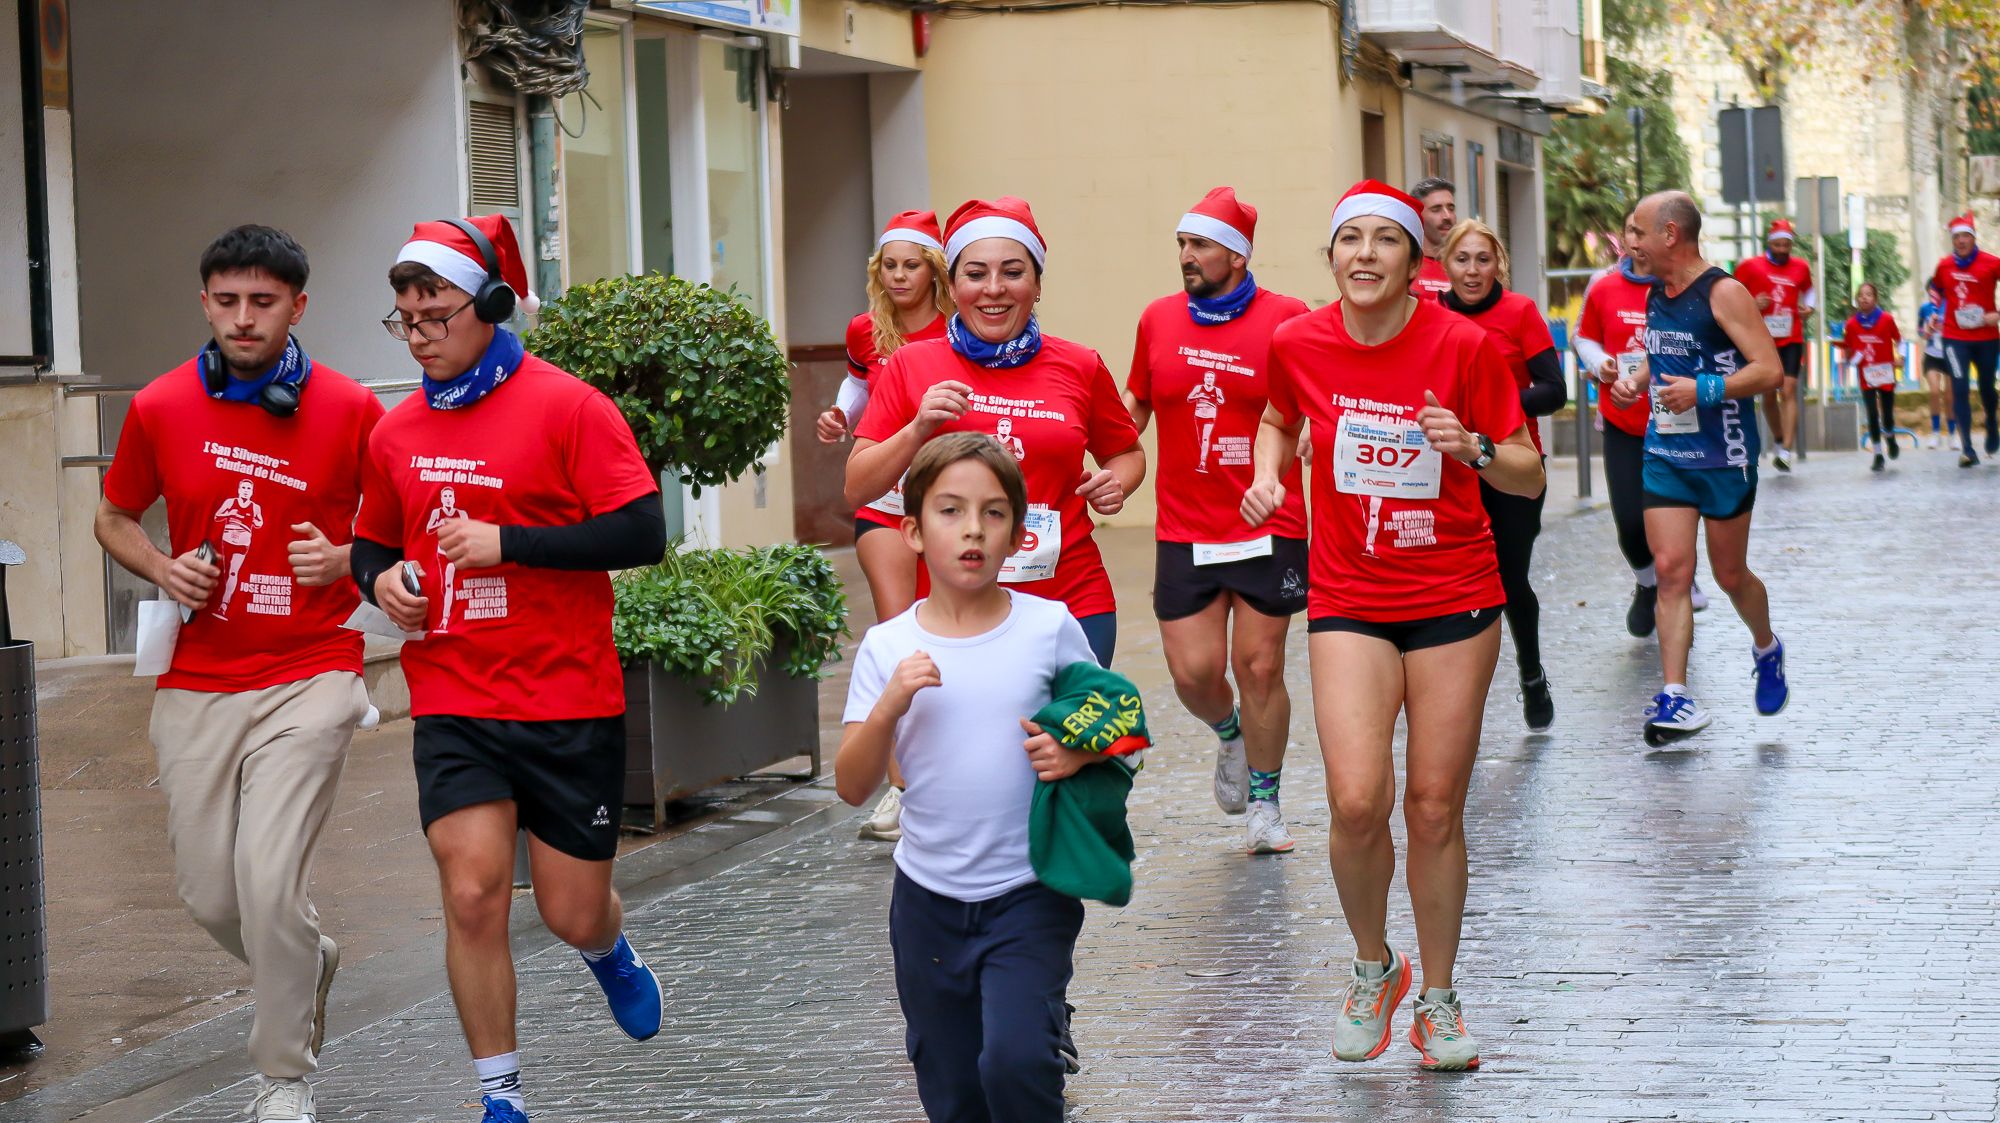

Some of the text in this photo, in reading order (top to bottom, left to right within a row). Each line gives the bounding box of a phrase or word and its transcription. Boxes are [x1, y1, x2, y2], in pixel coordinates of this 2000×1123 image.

[1660, 331, 1693, 341] NOCTURNA
[1183, 347, 1198, 357] San
[1199, 349, 1233, 362] Silvestre
[1187, 356, 1254, 377] Ciudad de Lucena
[967, 392, 1035, 408] San Silvestre
[1332, 393, 1405, 415] I San Silvestre
[973, 403, 1065, 422] Ciudad de Lucena
[1347, 431, 1368, 439] Ciudad
[1378, 436, 1400, 444] Lucena
[1361, 426, 1387, 436] Silvestre
[203, 441, 280, 468] I San Silvestre
[1356, 444, 1421, 468] 307
[410, 456, 417, 468] I
[416, 456, 434, 468] San
[434, 456, 476, 471] Silvestre
[216, 456, 307, 491] Ciudad de Lucena
[420, 469, 503, 489] Ciudad de Lucena
[1392, 510, 1434, 521] MEMORIAL
[1384, 519, 1434, 531] JOSE CARLOS
[1398, 527, 1433, 538] HURTADO
[250, 574, 292, 585] MEMORIAL
[463, 577, 506, 589] MEMORIAL
[240, 582, 291, 595] JOSE CARLOS
[456, 587, 507, 600] JOSE CARLOS
[253, 594, 290, 605] HURTADO
[469, 597, 507, 608] HURTADO
[247, 603, 290, 616] MARJALIZO
[464, 607, 507, 620] MARJALIZO
